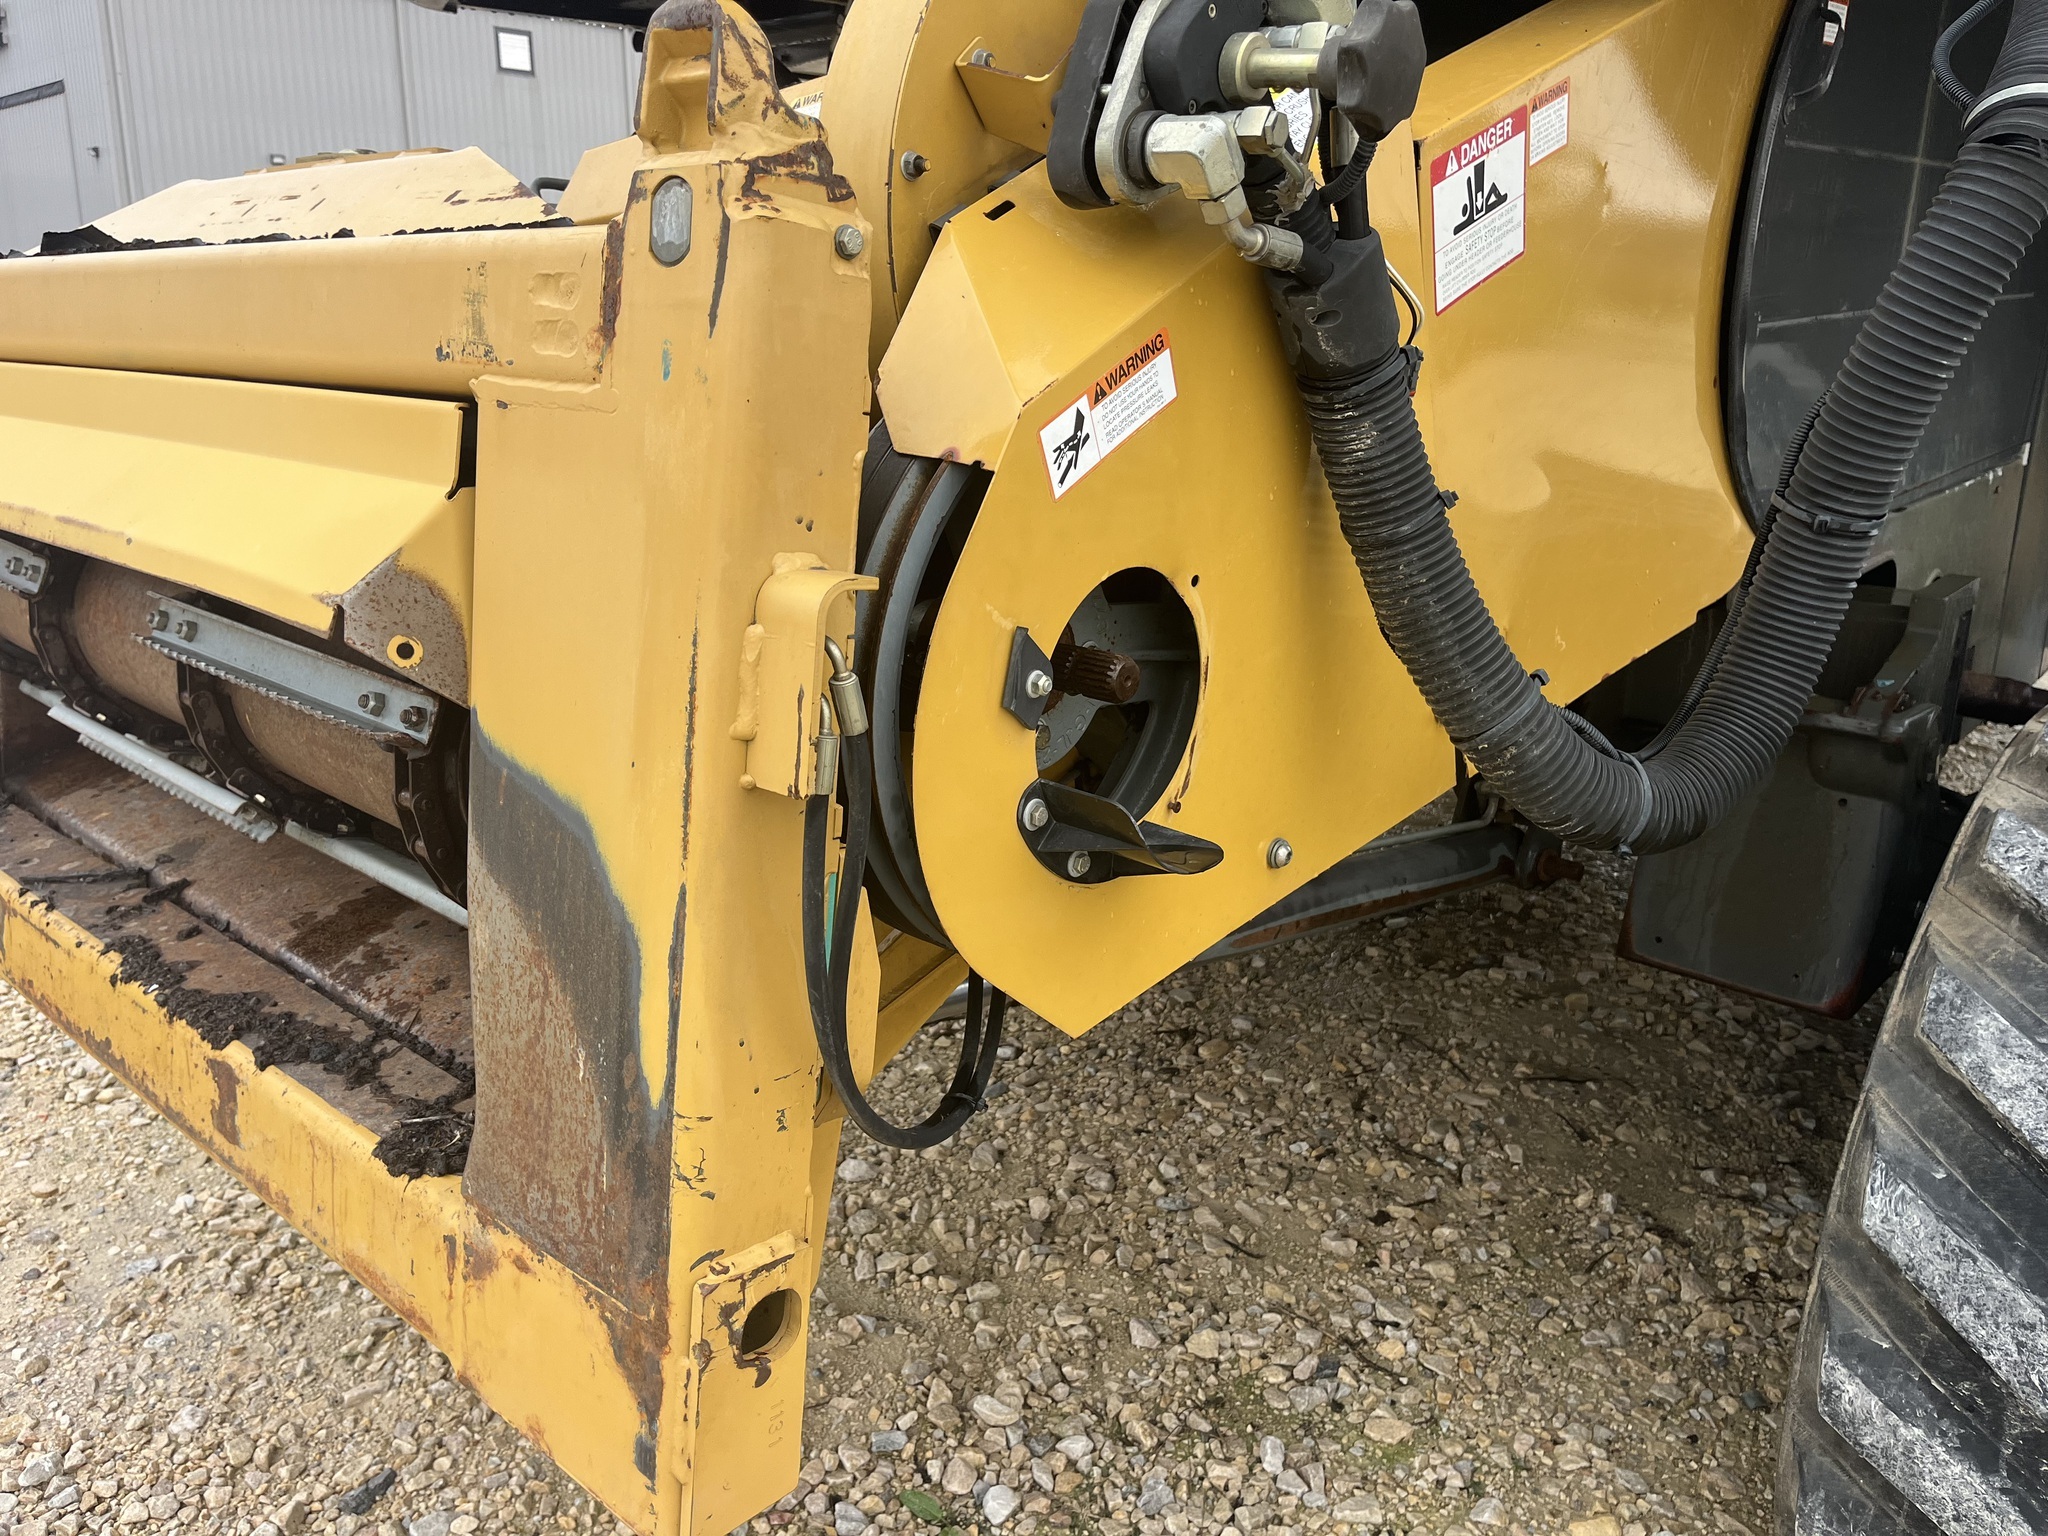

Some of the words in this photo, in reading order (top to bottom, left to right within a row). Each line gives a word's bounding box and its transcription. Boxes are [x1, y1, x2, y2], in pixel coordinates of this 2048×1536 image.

[1538, 82, 1567, 107] WARNING
[1461, 117, 1513, 164] DANGER
[1438, 268, 1451, 283] GOING
[1453, 257, 1466, 273] UNDER
[1468, 245, 1485, 262] HEADER
[1486, 240, 1492, 250] OR
[1493, 220, 1520, 245] FEEDERHOUSE
[1443, 248, 1449, 258] TO
[1450, 239, 1462, 253] AVOID
[1463, 226, 1481, 244] SERIOUS
[1483, 216, 1496, 231] INJURY
[1498, 211, 1503, 220] OR
[1504, 202, 1516, 216] DEATH
[1445, 251, 1463, 269] ENGAGE
[1465, 234, 1482, 255] SAFETY
[1484, 225, 1495, 242] STOP
[1497, 216, 1513, 233] BEFORE
[1101, 402, 1108, 411] TO
[1108, 390, 1122, 405] AVOID
[1122, 374, 1141, 394] SERIOUS
[1142, 361, 1156, 377] INJURY
[1104, 334, 1164, 390] WARNING
[1101, 411, 1108, 421] DO
[1108, 404, 1118, 415] NOT
[1118, 396, 1126, 407] USE
[1127, 386, 1138, 399] YOUR
[1139, 375, 1152, 390] HANDS
[1152, 370, 1158, 379] TO
[1103, 411, 1120, 429] LOCATE
[1120, 391, 1144, 414] PRESSURE
[1144, 380, 1158, 394] LEAKS
[1105, 423, 1118, 438] READ
[1146, 387, 1162, 404] MANUAL
[1107, 434, 1115, 445] FOR
[1115, 414, 1138, 437] ADDITIONAL
